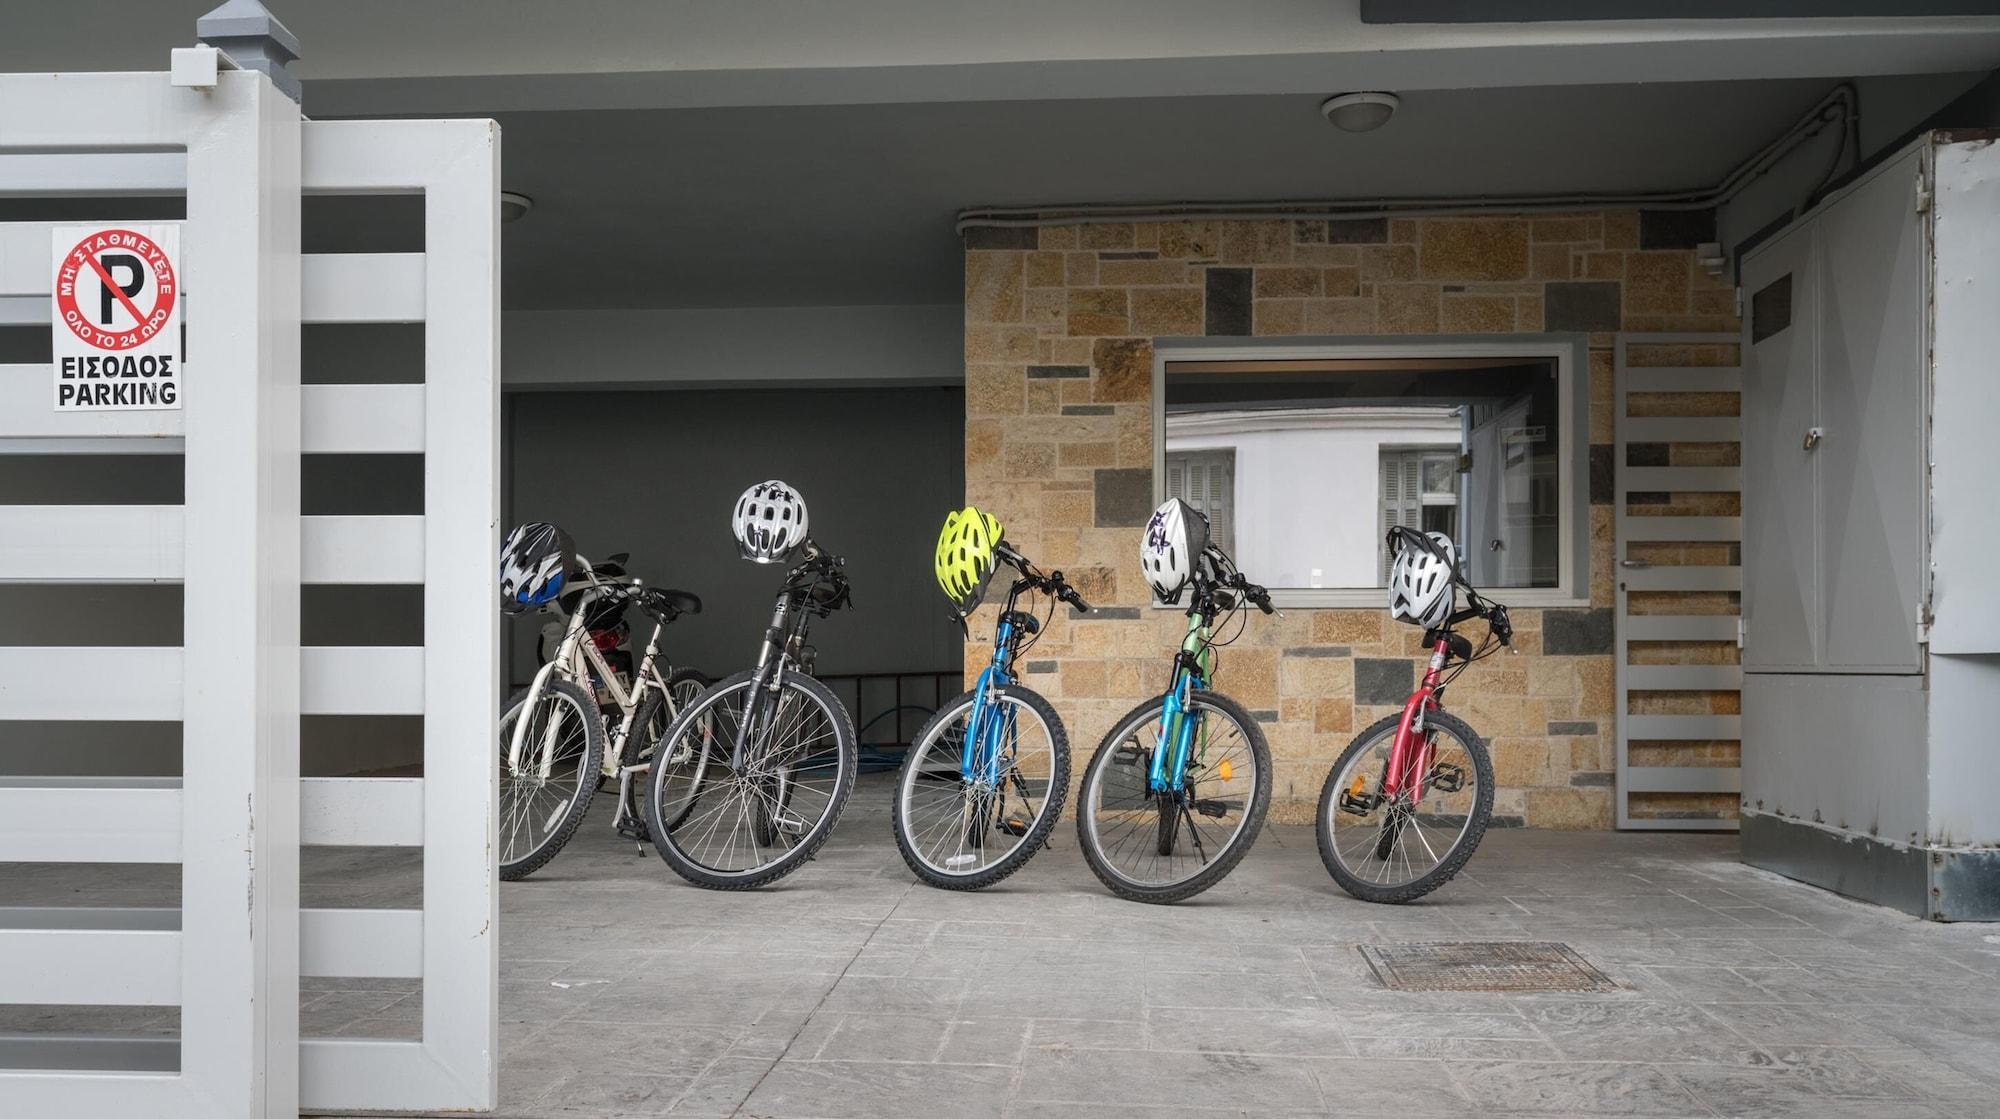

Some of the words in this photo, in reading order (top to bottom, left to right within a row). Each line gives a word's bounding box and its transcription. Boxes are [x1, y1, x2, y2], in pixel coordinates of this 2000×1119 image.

[73, 233, 172, 295] ΣΤΑΘΜΕΥΕΤΕ
[100, 254, 145, 325] P
[66, 310, 92, 339] ΟΛΟ
[95, 334, 116, 347] ΤΟ
[120, 333, 138, 348] 24
[141, 308, 167, 339] ΩΡΟ
[61, 355, 173, 379] ΕΙΣΟΔΟΣ
[59, 382, 176, 406] PARKING
